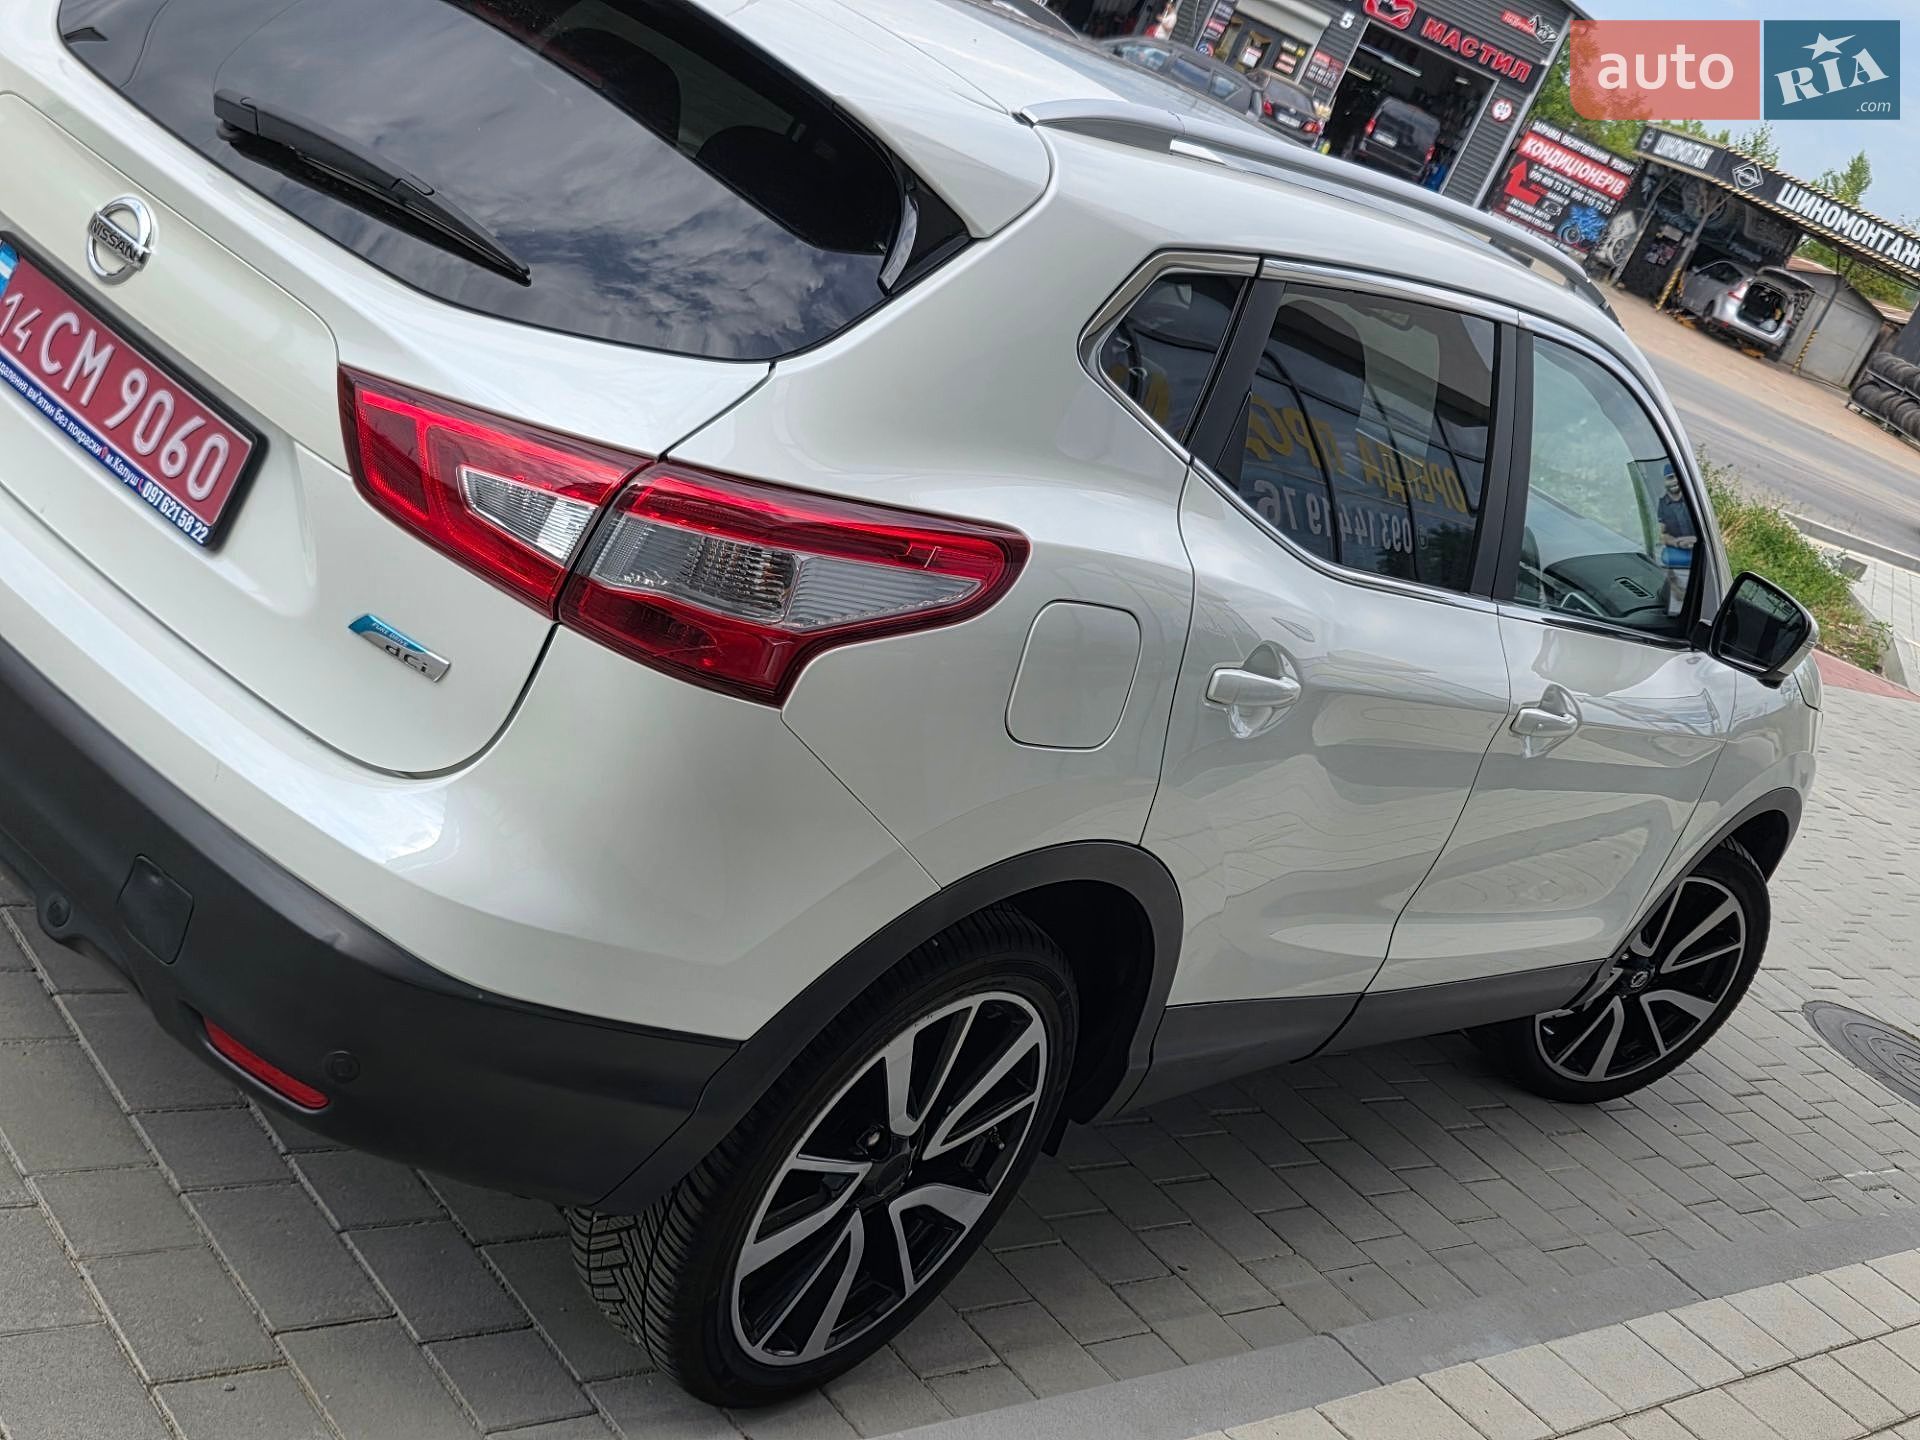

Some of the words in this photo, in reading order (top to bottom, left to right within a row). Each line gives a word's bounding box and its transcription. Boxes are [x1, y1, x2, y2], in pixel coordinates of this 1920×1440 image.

[1339, 12, 1354, 29] 5
[1420, 16, 1533, 84] МАСТИЛ
[1523, 137, 1626, 196] КОНДИЦІОНЕРІВ
[90, 217, 148, 266] NISSAN
[1776, 183, 1920, 271] ШИНОМОНТАЖ
[104, 368, 230, 501] 9060
[54, 403, 68, 430] без
[68, 421, 102, 459] покраски
[142, 482, 162, 506] 097
[160, 494, 178, 521] 621
[176, 507, 194, 534] 58
[190, 521, 208, 544] 22
[385, 644, 428, 673] dCi
